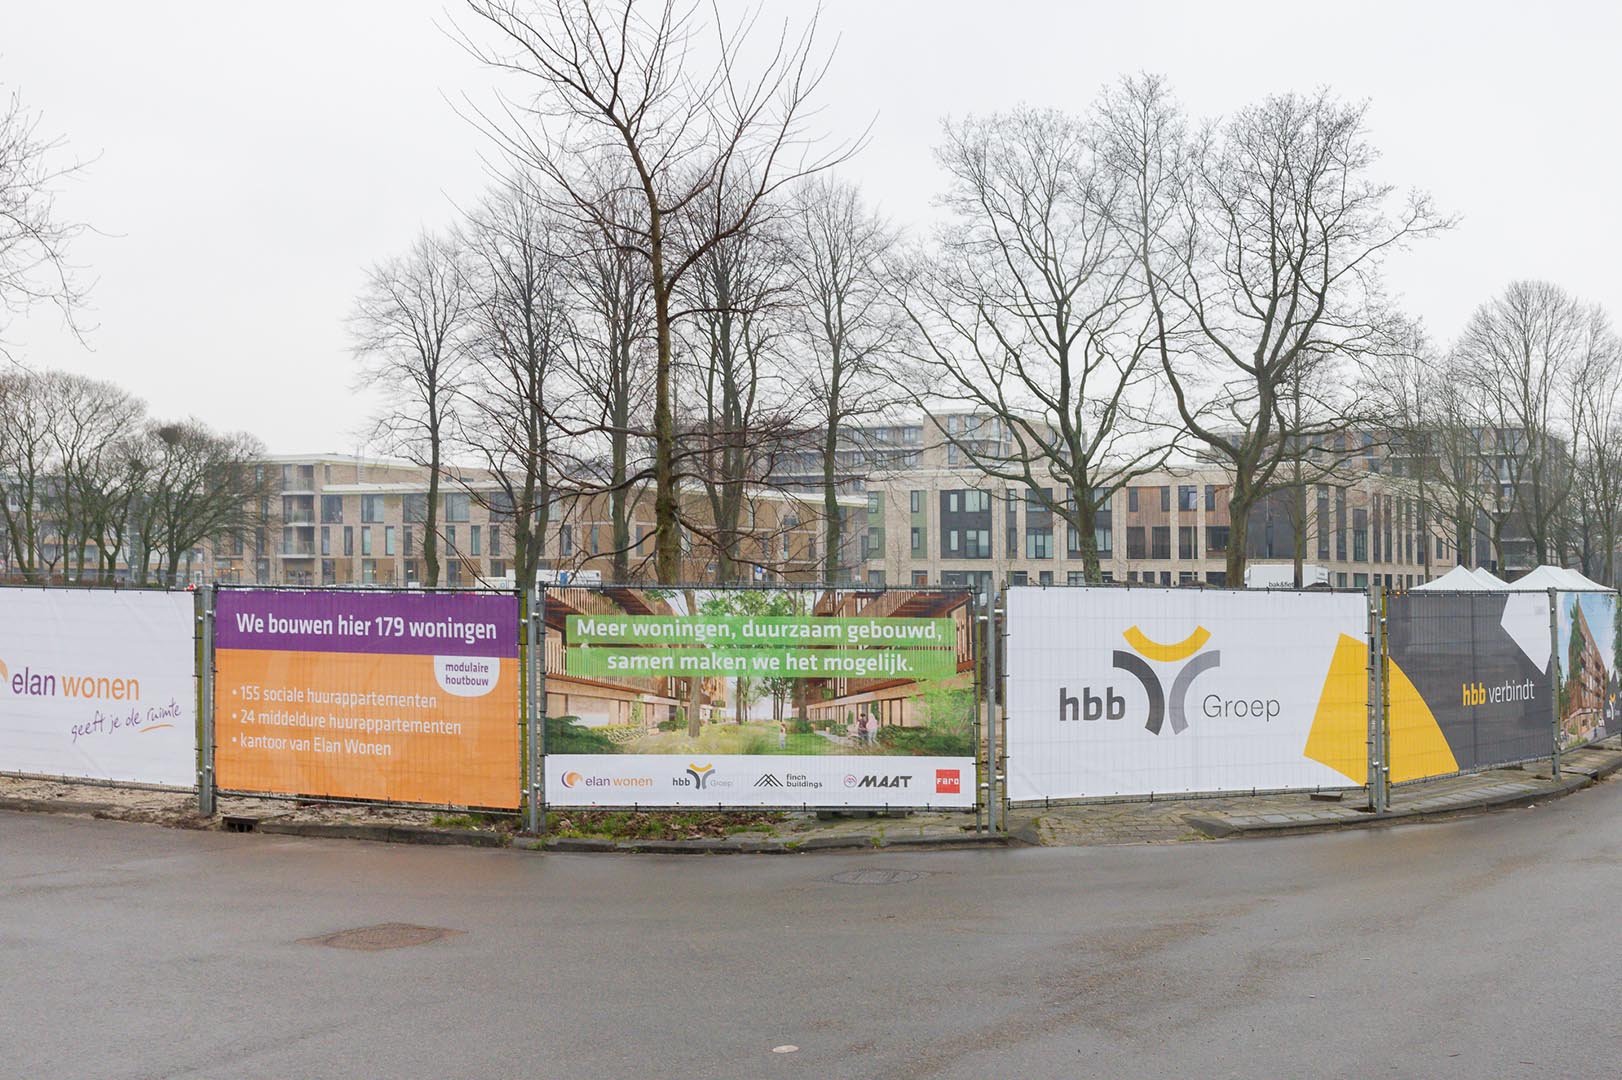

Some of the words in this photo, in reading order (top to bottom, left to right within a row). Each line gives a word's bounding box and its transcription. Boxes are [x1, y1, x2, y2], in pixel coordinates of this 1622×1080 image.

[236, 613, 264, 634] We
[268, 613, 334, 636] bouwen
[338, 615, 371, 637] hier
[375, 616, 404, 637] 179
[409, 617, 497, 645] woningen
[577, 619, 627, 636] Meer
[633, 620, 736, 641] woningen,
[742, 620, 841, 637] duurzaam
[848, 620, 942, 643] gebouwd,
[445, 662, 489, 673] modulaire
[607, 655, 673, 669] samen
[680, 652, 746, 670] maken
[752, 657, 779, 670] we
[786, 653, 817, 670] het
[824, 653, 913, 675] mogelijk.
[12, 666, 56, 696] elan
[62, 675, 139, 700] wonen
[445, 675, 489, 686] houtbouw
[1462, 682, 1486, 706] hbb
[1488, 679, 1535, 703] verbindt
[240, 685, 260, 702] 155
[263, 686, 304, 703] sociale
[307, 688, 437, 709] huurappartementen
[1059, 686, 1126, 721] hbb
[1202, 694, 1281, 722] Groep
[71, 710, 104, 744] geeft
[109, 714, 121, 735] je
[125, 708, 141, 725] de
[147, 697, 182, 722] ruimte
[240, 710, 255, 725] 24
[258, 711, 325, 728] middeldure
[328, 715, 461, 736] huurappartementen
[240, 732, 287, 750] kantoor
[289, 739, 310, 752] van
[314, 736, 341, 753] Elan
[344, 738, 392, 756] Wonen
[585, 775, 611, 787] elan
[613, 777, 653, 787] wonen
[672, 777, 690, 787] hbb
[786, 781, 823, 789] buildings
[857, 775, 912, 788] MAAT
